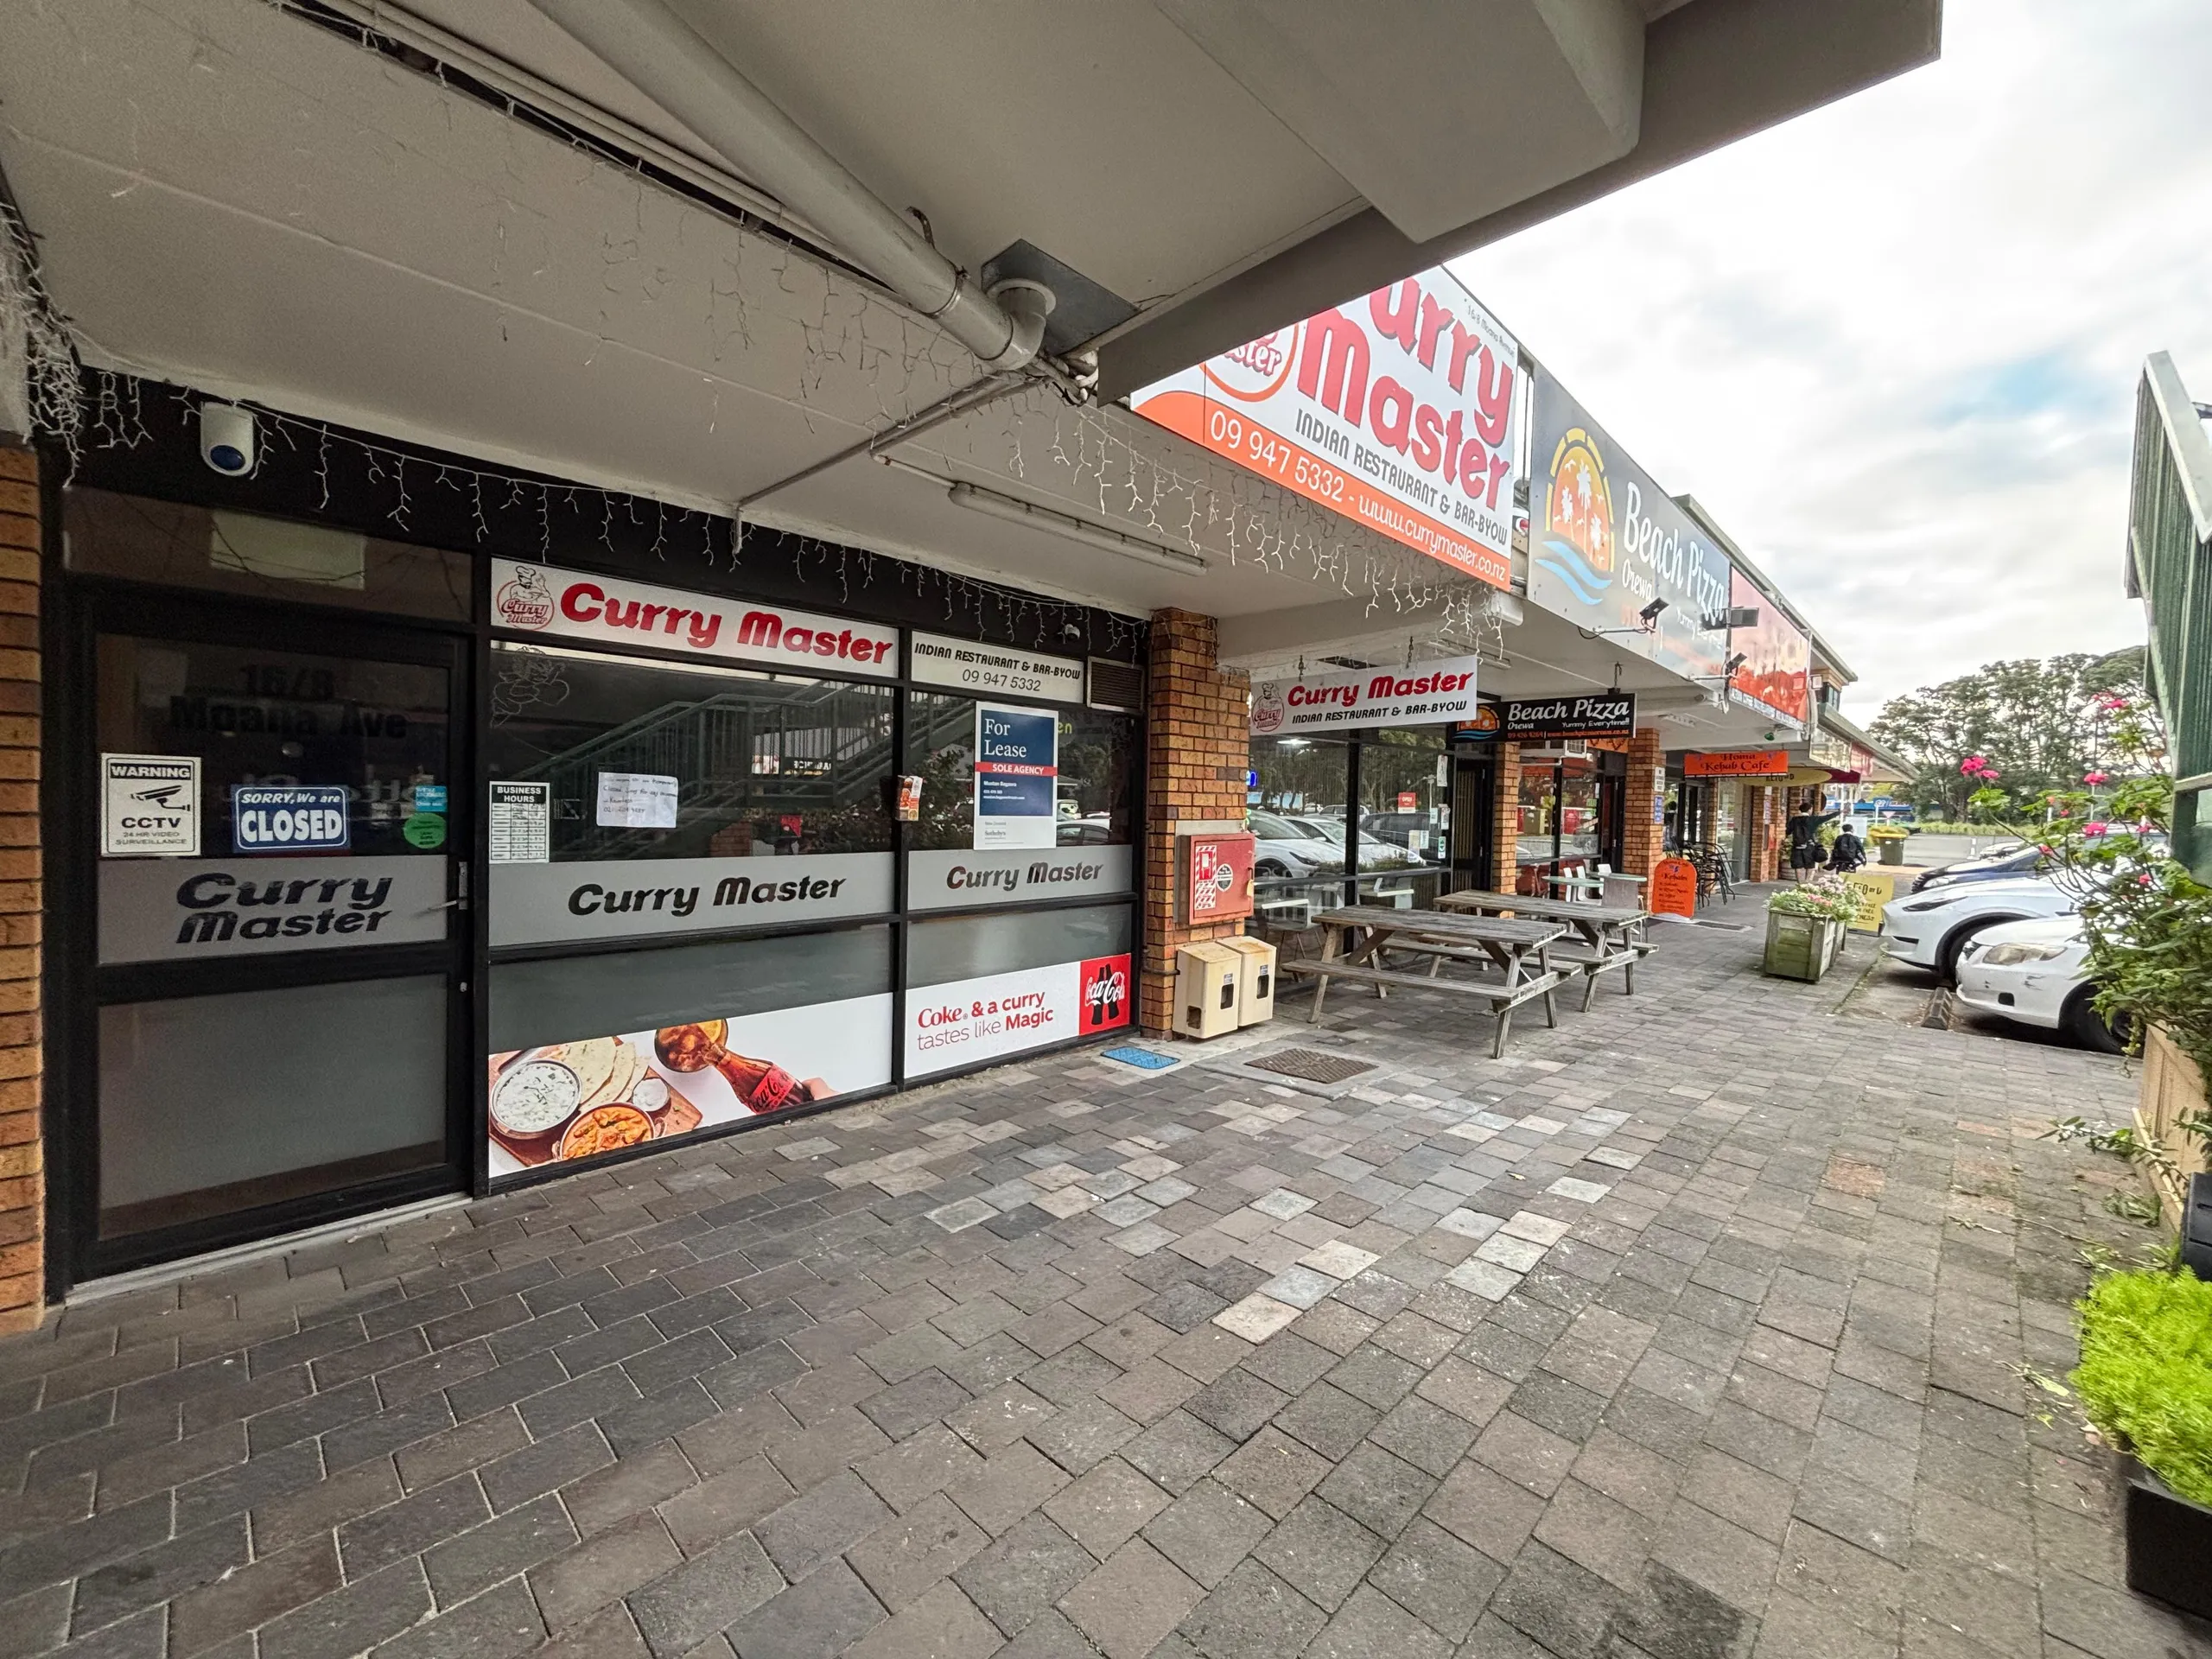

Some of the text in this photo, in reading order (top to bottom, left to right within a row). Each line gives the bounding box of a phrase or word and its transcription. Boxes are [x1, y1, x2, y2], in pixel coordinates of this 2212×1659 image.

[1224, 342, 1281, 377] ster
[1370, 276, 1514, 448] urry
[1297, 306, 1511, 509] Master
[1296, 408, 1508, 547] INDIAN RESTAURANT & BAR-BYOW
[1211, 410, 1242, 448] 09
[1249, 433, 1291, 474] 947
[1296, 457, 1344, 502] 5332
[1358, 495, 1506, 582] www.currymaster.co.nz
[1622, 482, 1726, 627] Beach Pizza
[1621, 557, 1654, 602] Orewa
[501, 599, 549, 618] Curry
[560, 582, 894, 664] Curry Master
[914, 643, 1081, 680] INDIAN RESTAURANT & BAR-BYOW
[962, 669, 1041, 691] 09 947 5332
[1287, 671, 1474, 708] Curry Master
[1292, 701, 1467, 724] INDIAN RESTAURANT & BAR-BYOW
[1508, 698, 1630, 721] Beach Pizza
[1562, 721, 1586, 730] Yummy
[984, 718, 1011, 735] For
[984, 739, 1027, 758] Lease
[111, 766, 190, 778] WARNING
[992, 763, 1045, 775] SOLE AGENCY
[1741, 760, 1770, 772] Cafe
[241, 792, 340, 804] SORRY, We are
[497, 786, 541, 795] BUSINESS
[121, 817, 181, 828] CCTV
[240, 809, 344, 842] CLOSED
[175, 872, 393, 910] Curry
[946, 861, 1104, 892] Curry Master
[568, 875, 847, 917] Curry Master
[175, 907, 393, 944] Master
[971, 1001, 984, 1018] &
[987, 1001, 998, 1014] a
[1001, 992, 1046, 1011] curry
[1085, 971, 1126, 1007] Coca-Cola
[917, 1007, 1054, 1051] tastes like Magic
